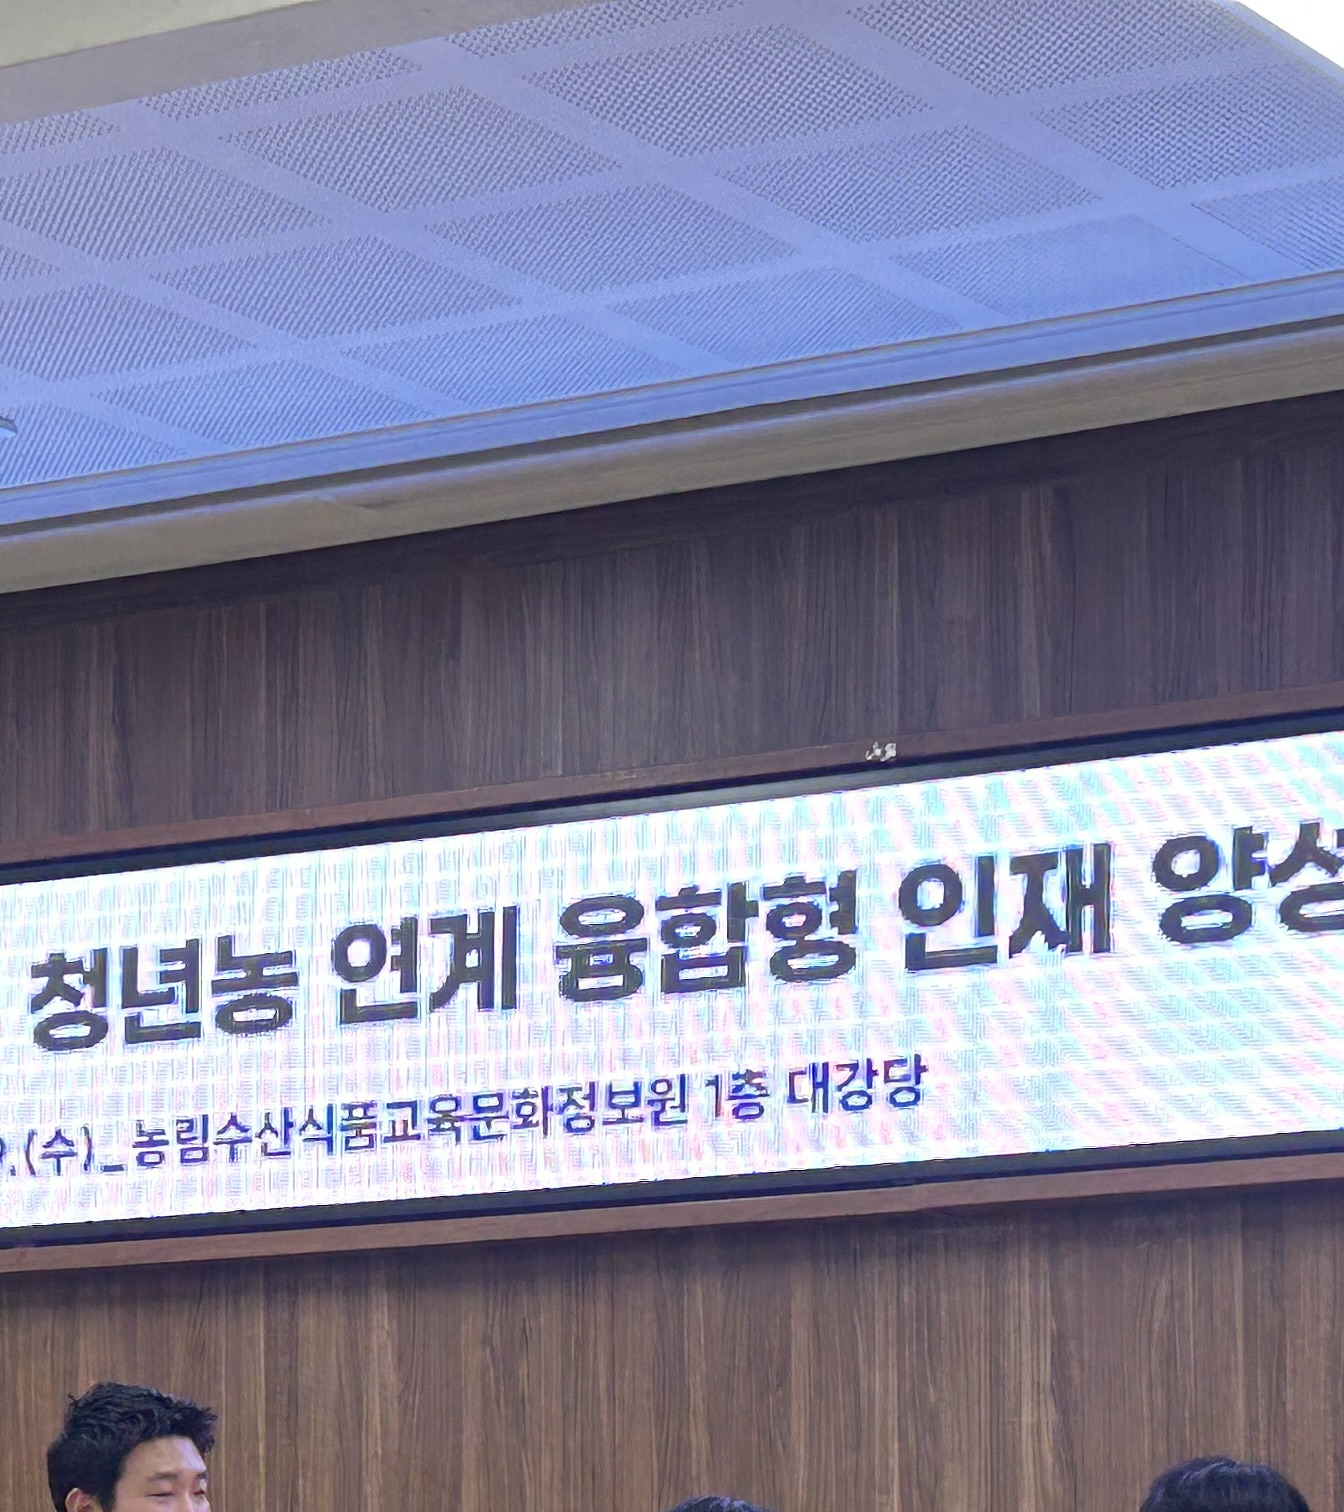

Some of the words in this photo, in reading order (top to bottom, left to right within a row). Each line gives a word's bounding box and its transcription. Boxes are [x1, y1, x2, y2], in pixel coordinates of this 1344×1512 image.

[30, 933, 300, 1051] 청년농
[331, 904, 518, 1025] 연계
[555, 870, 858, 1002] 융합형
[897, 841, 1113, 973] 인재
[705, 1069, 771, 1120] 1층
[787, 1054, 929, 1114] 대강당
